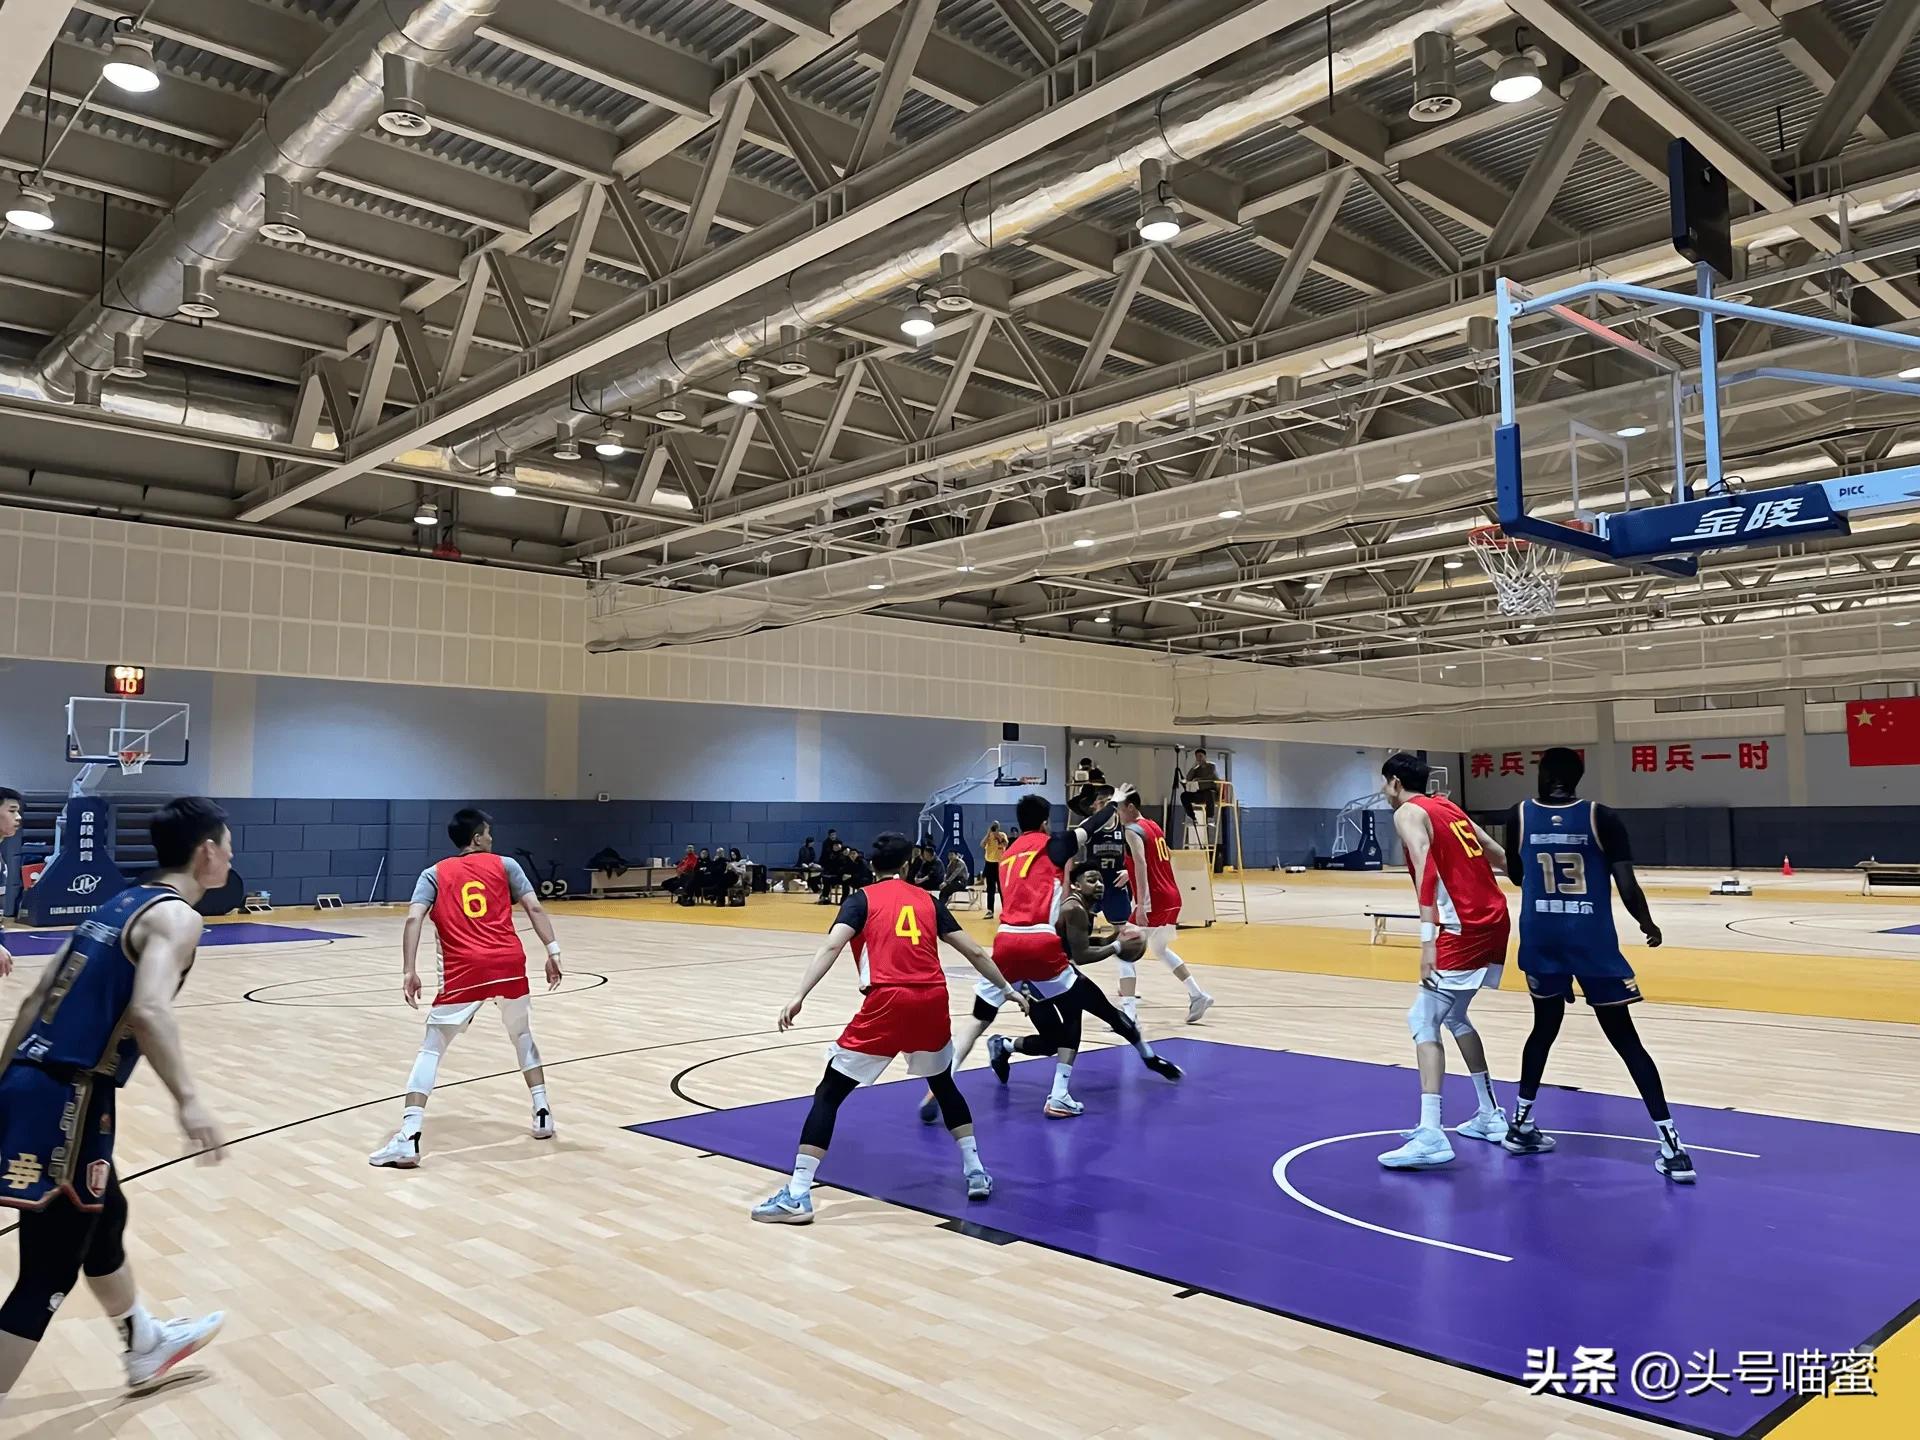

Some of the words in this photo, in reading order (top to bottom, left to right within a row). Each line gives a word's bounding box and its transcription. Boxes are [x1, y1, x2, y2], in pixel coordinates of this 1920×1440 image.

[1839, 485, 1865, 498] PICC
[1672, 497, 1829, 542] 金陵
[119, 678, 137, 693] 10
[1471, 749, 1585, 779] 养兵
[1631, 740, 1770, 773] 用兵一时
[1155, 836, 1170, 861] 10
[1449, 820, 1484, 858] 15
[1000, 850, 1039, 888] 77
[1536, 852, 1588, 894] 13
[460, 880, 488, 919] 6
[895, 905, 922, 945] 4
